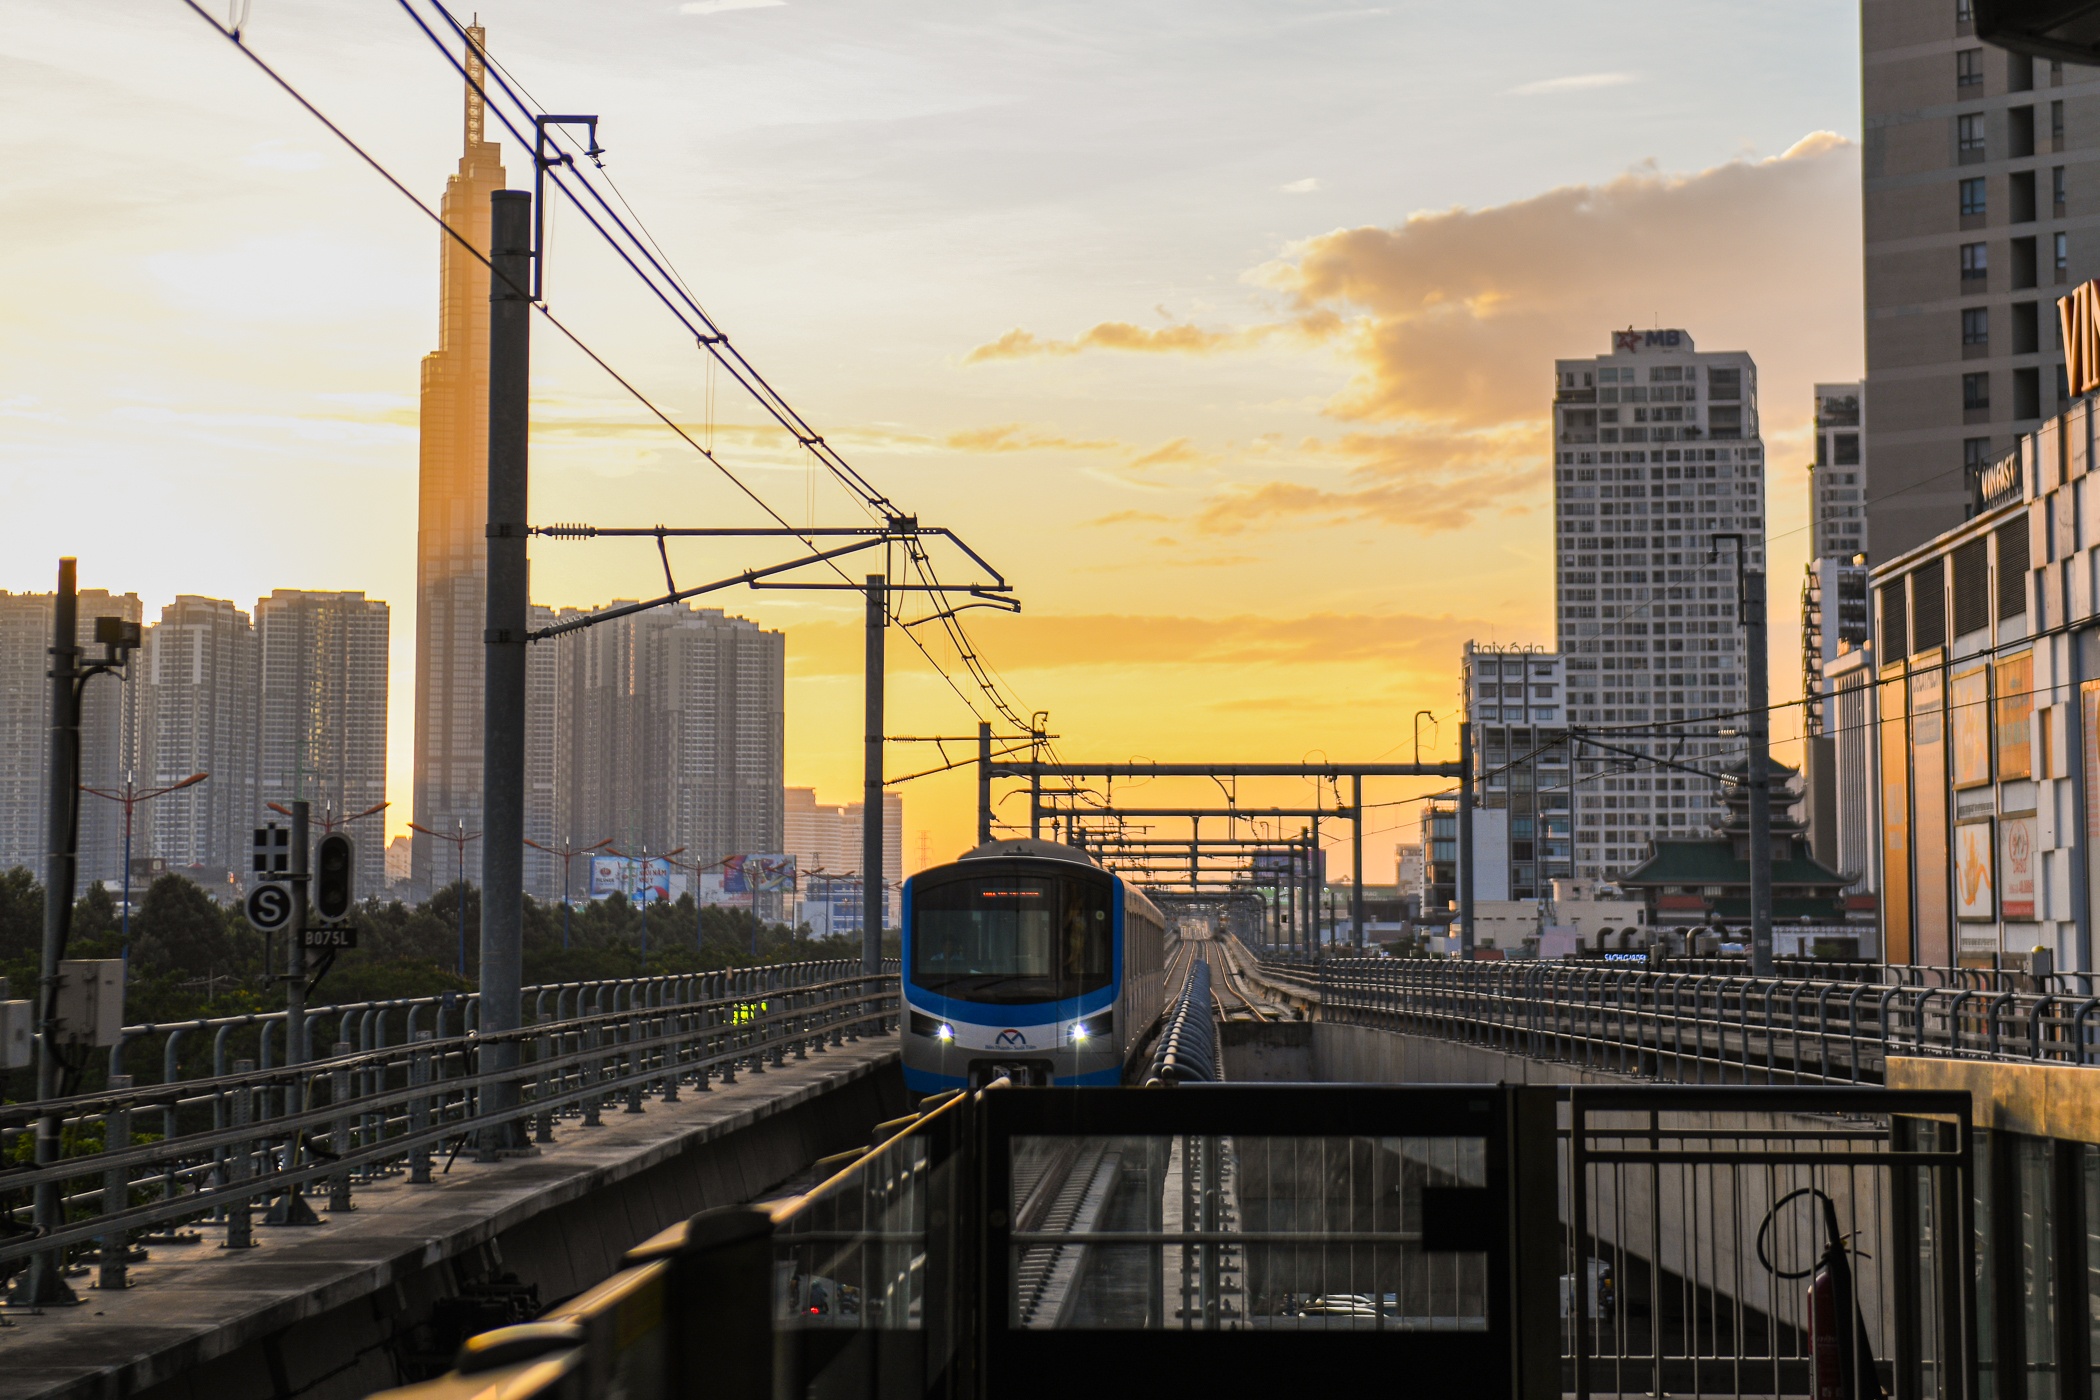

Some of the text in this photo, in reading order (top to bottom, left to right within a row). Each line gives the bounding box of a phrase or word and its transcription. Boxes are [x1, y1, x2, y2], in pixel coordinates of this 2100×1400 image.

[1645, 329, 1680, 347] MB
[258, 890, 281, 922] S
[305, 931, 349, 945] B075L
